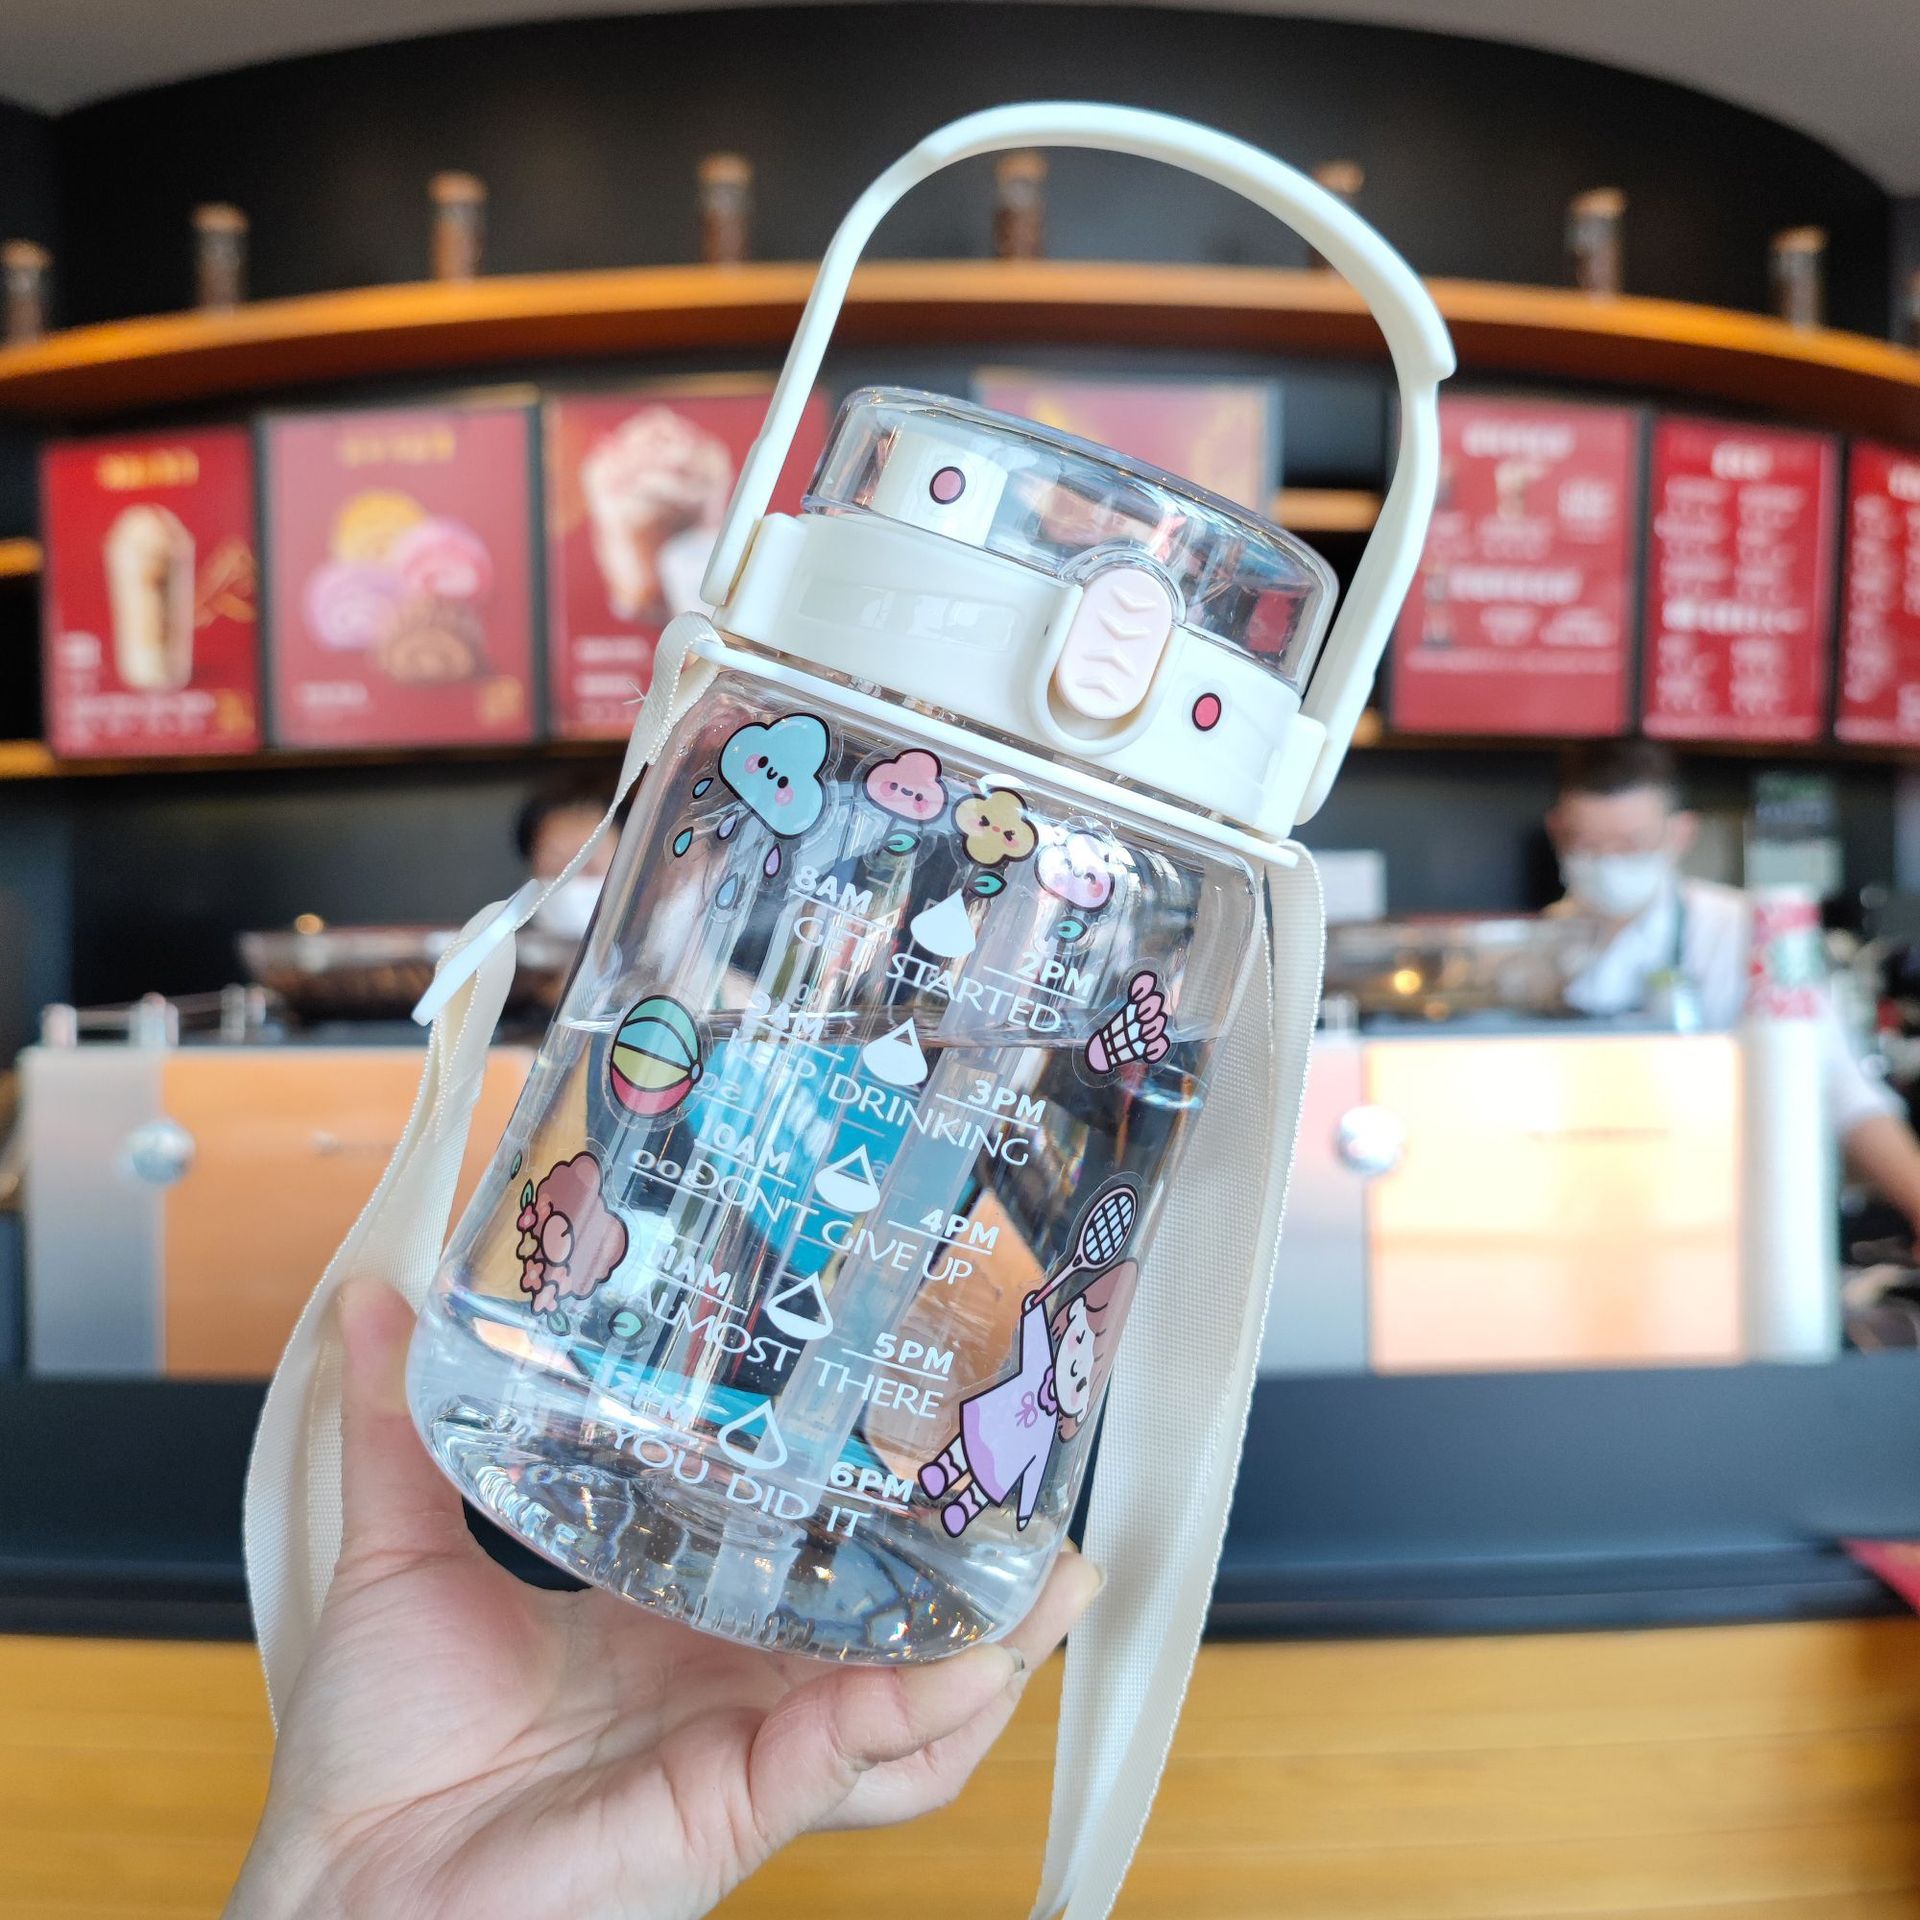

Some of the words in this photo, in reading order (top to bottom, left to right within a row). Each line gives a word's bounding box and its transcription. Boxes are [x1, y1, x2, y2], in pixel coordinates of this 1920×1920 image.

[795, 865, 873, 917] 8AM
[886, 952, 1061, 1032] STARTED
[1016, 951, 1093, 997] 2PM
[828, 1073, 1029, 1166] DRINKING
[967, 1079, 1047, 1123] 3PM
[699, 1118, 791, 1176] 10AM
[692, 1158, 820, 1231] DON'T
[822, 1220, 917, 1271] GIVE
[922, 1250, 973, 1285] UP
[920, 1208, 1000, 1249] 4PM
[873, 1333, 954, 1375] 5PM
[814, 1356, 944, 1419] THERE
[604, 1420, 710, 1484] YOU
[726, 1472, 809, 1520] DID
[826, 1505, 872, 1538] IT
[830, 1461, 915, 1503] 6PM
